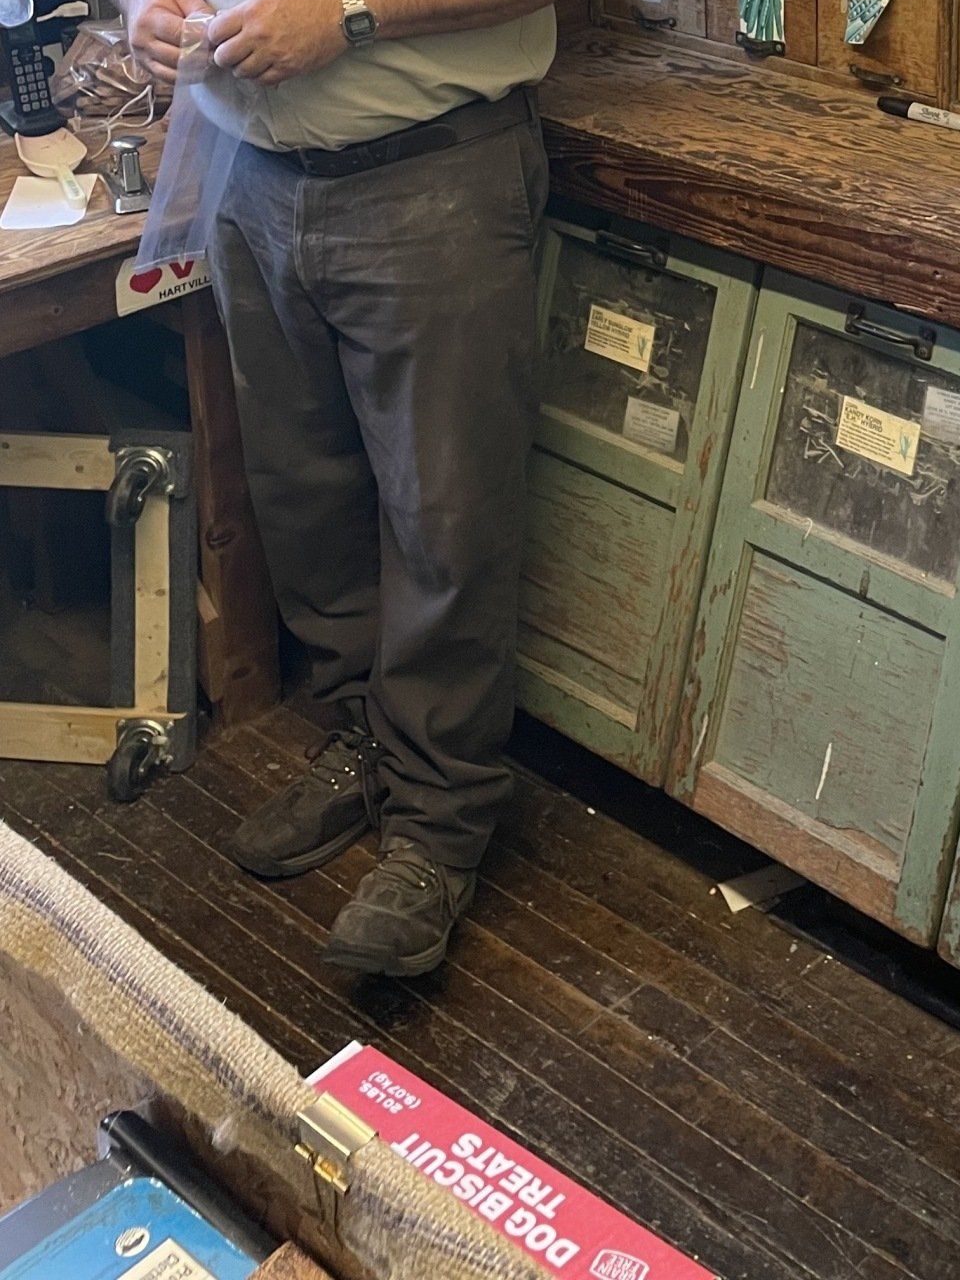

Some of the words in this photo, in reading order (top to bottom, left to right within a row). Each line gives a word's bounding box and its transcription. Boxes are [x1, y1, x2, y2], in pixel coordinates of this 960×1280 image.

[383, 1098, 404, 1114] 20
[390, 1132, 515, 1222] BISCUIT
[450, 1132, 566, 1220] TREATS
[504, 1206, 581, 1269] DOG
[608, 1253, 643, 1273] FREE
